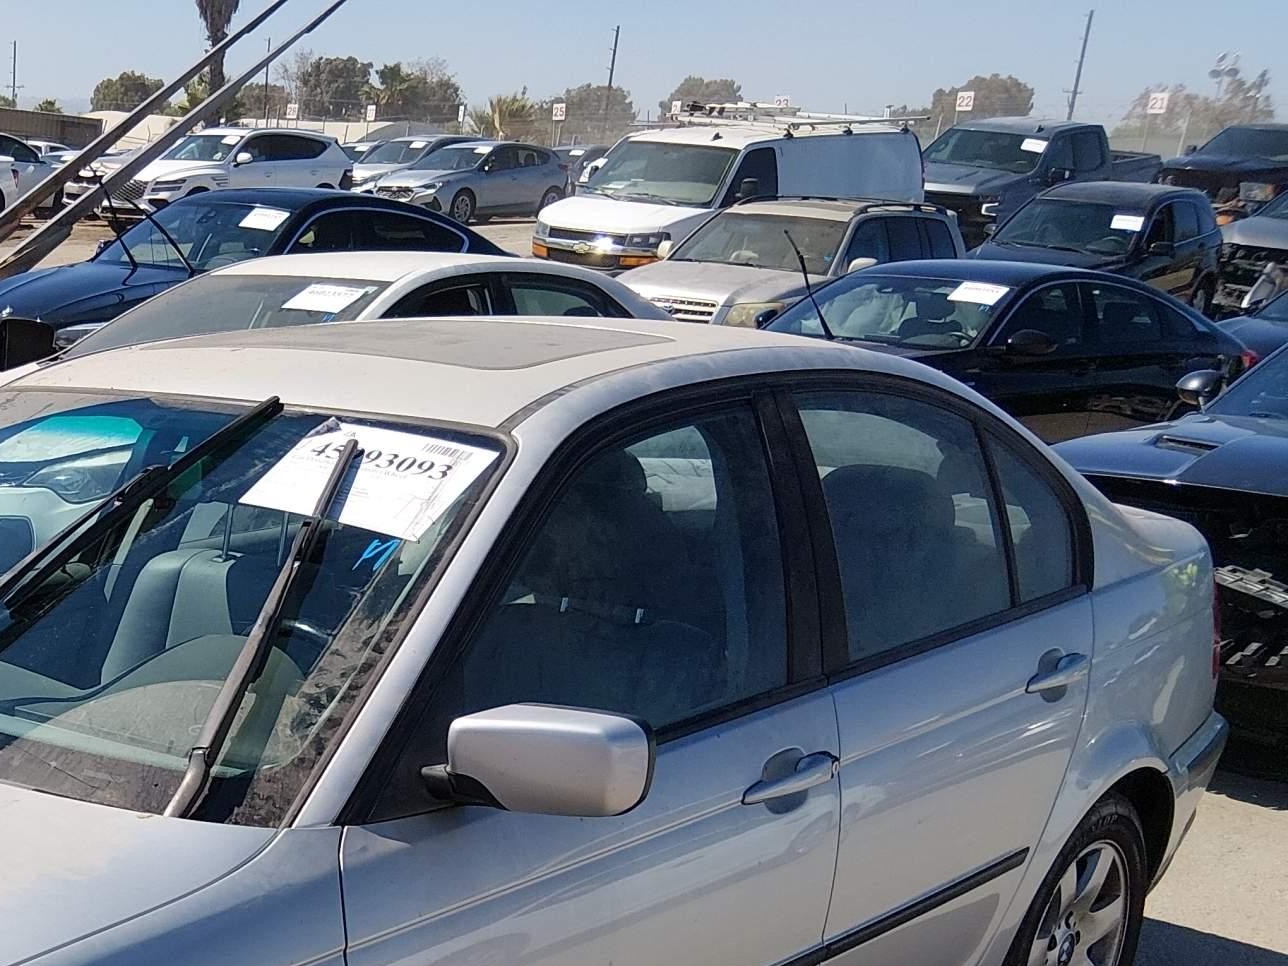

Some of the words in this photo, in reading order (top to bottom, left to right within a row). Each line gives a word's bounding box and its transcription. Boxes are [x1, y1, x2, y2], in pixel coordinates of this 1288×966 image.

[958, 95, 972, 108] 22
[1150, 95, 1165, 109] 21
[553, 107, 565, 117] 25
[311, 441, 455, 481] 4593093
